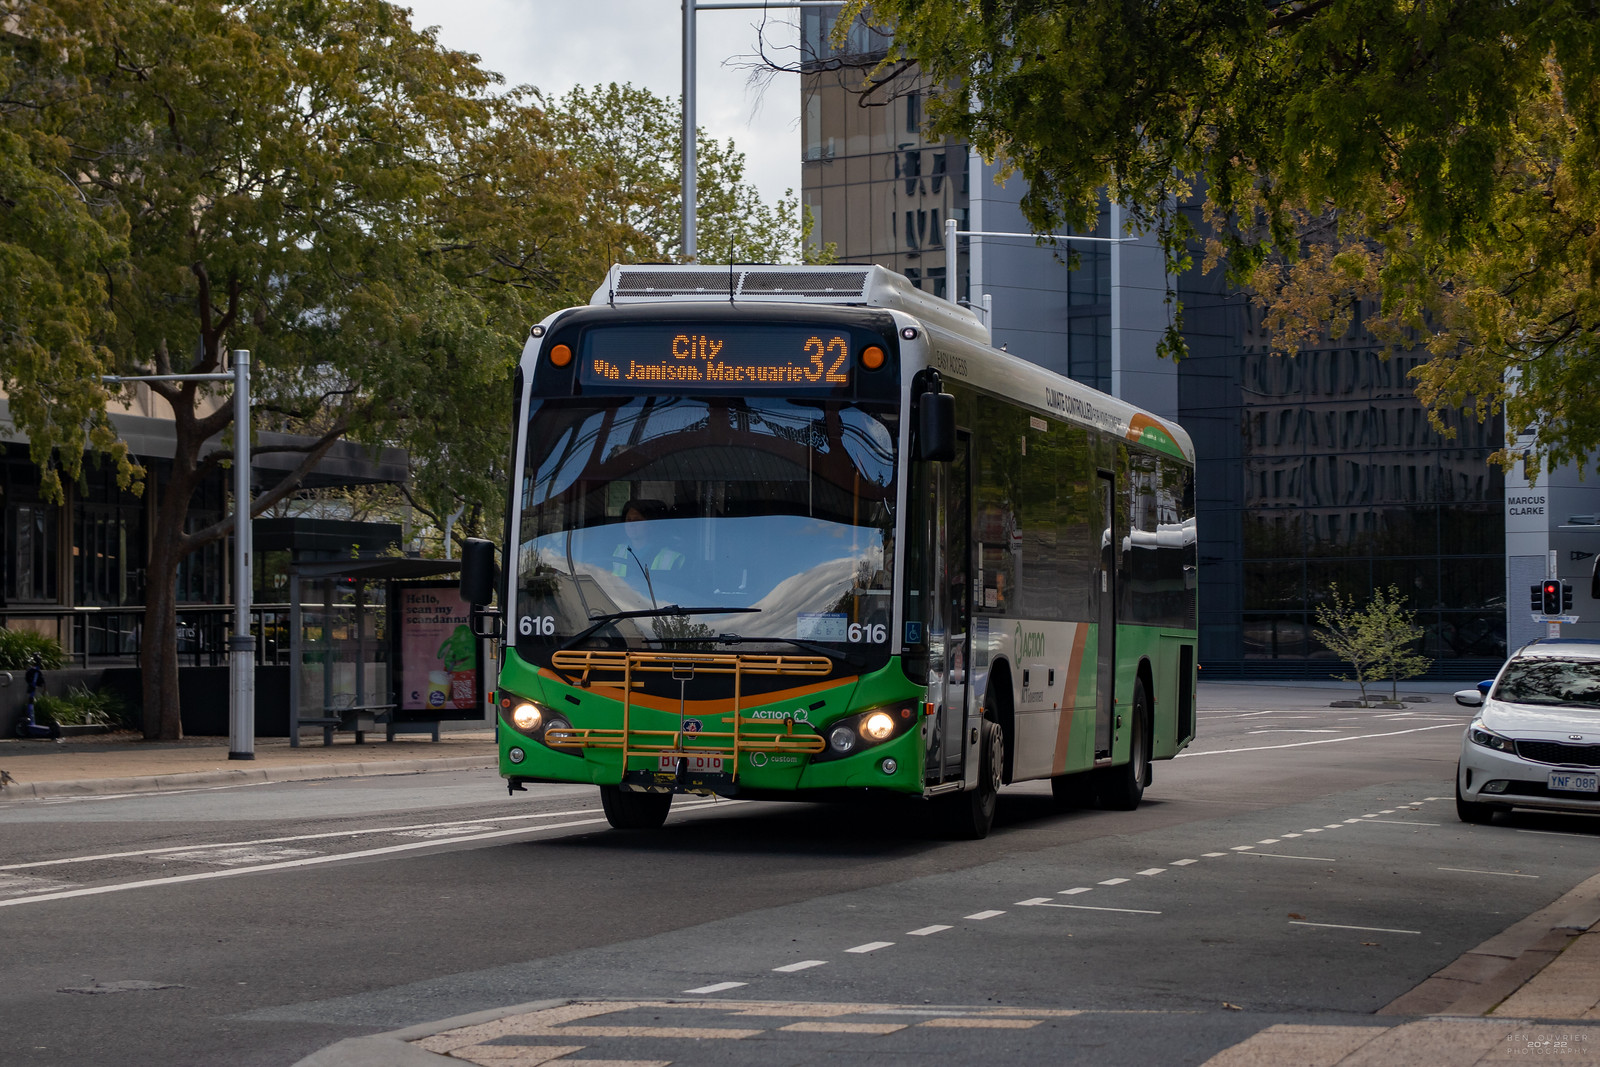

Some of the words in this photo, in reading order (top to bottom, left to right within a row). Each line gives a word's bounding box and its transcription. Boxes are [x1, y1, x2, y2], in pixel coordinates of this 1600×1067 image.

[672, 335, 723, 359] City
[803, 336, 848, 382] 32
[706, 361, 803, 382] Macquarie
[1508, 496, 1545, 505] MARCUS
[1509, 506, 1544, 515] CLARKE
[407, 594, 440, 605] Hello,
[407, 606, 432, 614] scan
[434, 606, 453, 616] my
[519, 615, 555, 636] 616
[847, 622, 887, 644] 616
[1022, 632, 1045, 658] ACTION
[752, 710, 791, 719] ACTION
[696, 752, 721, 768] 616
